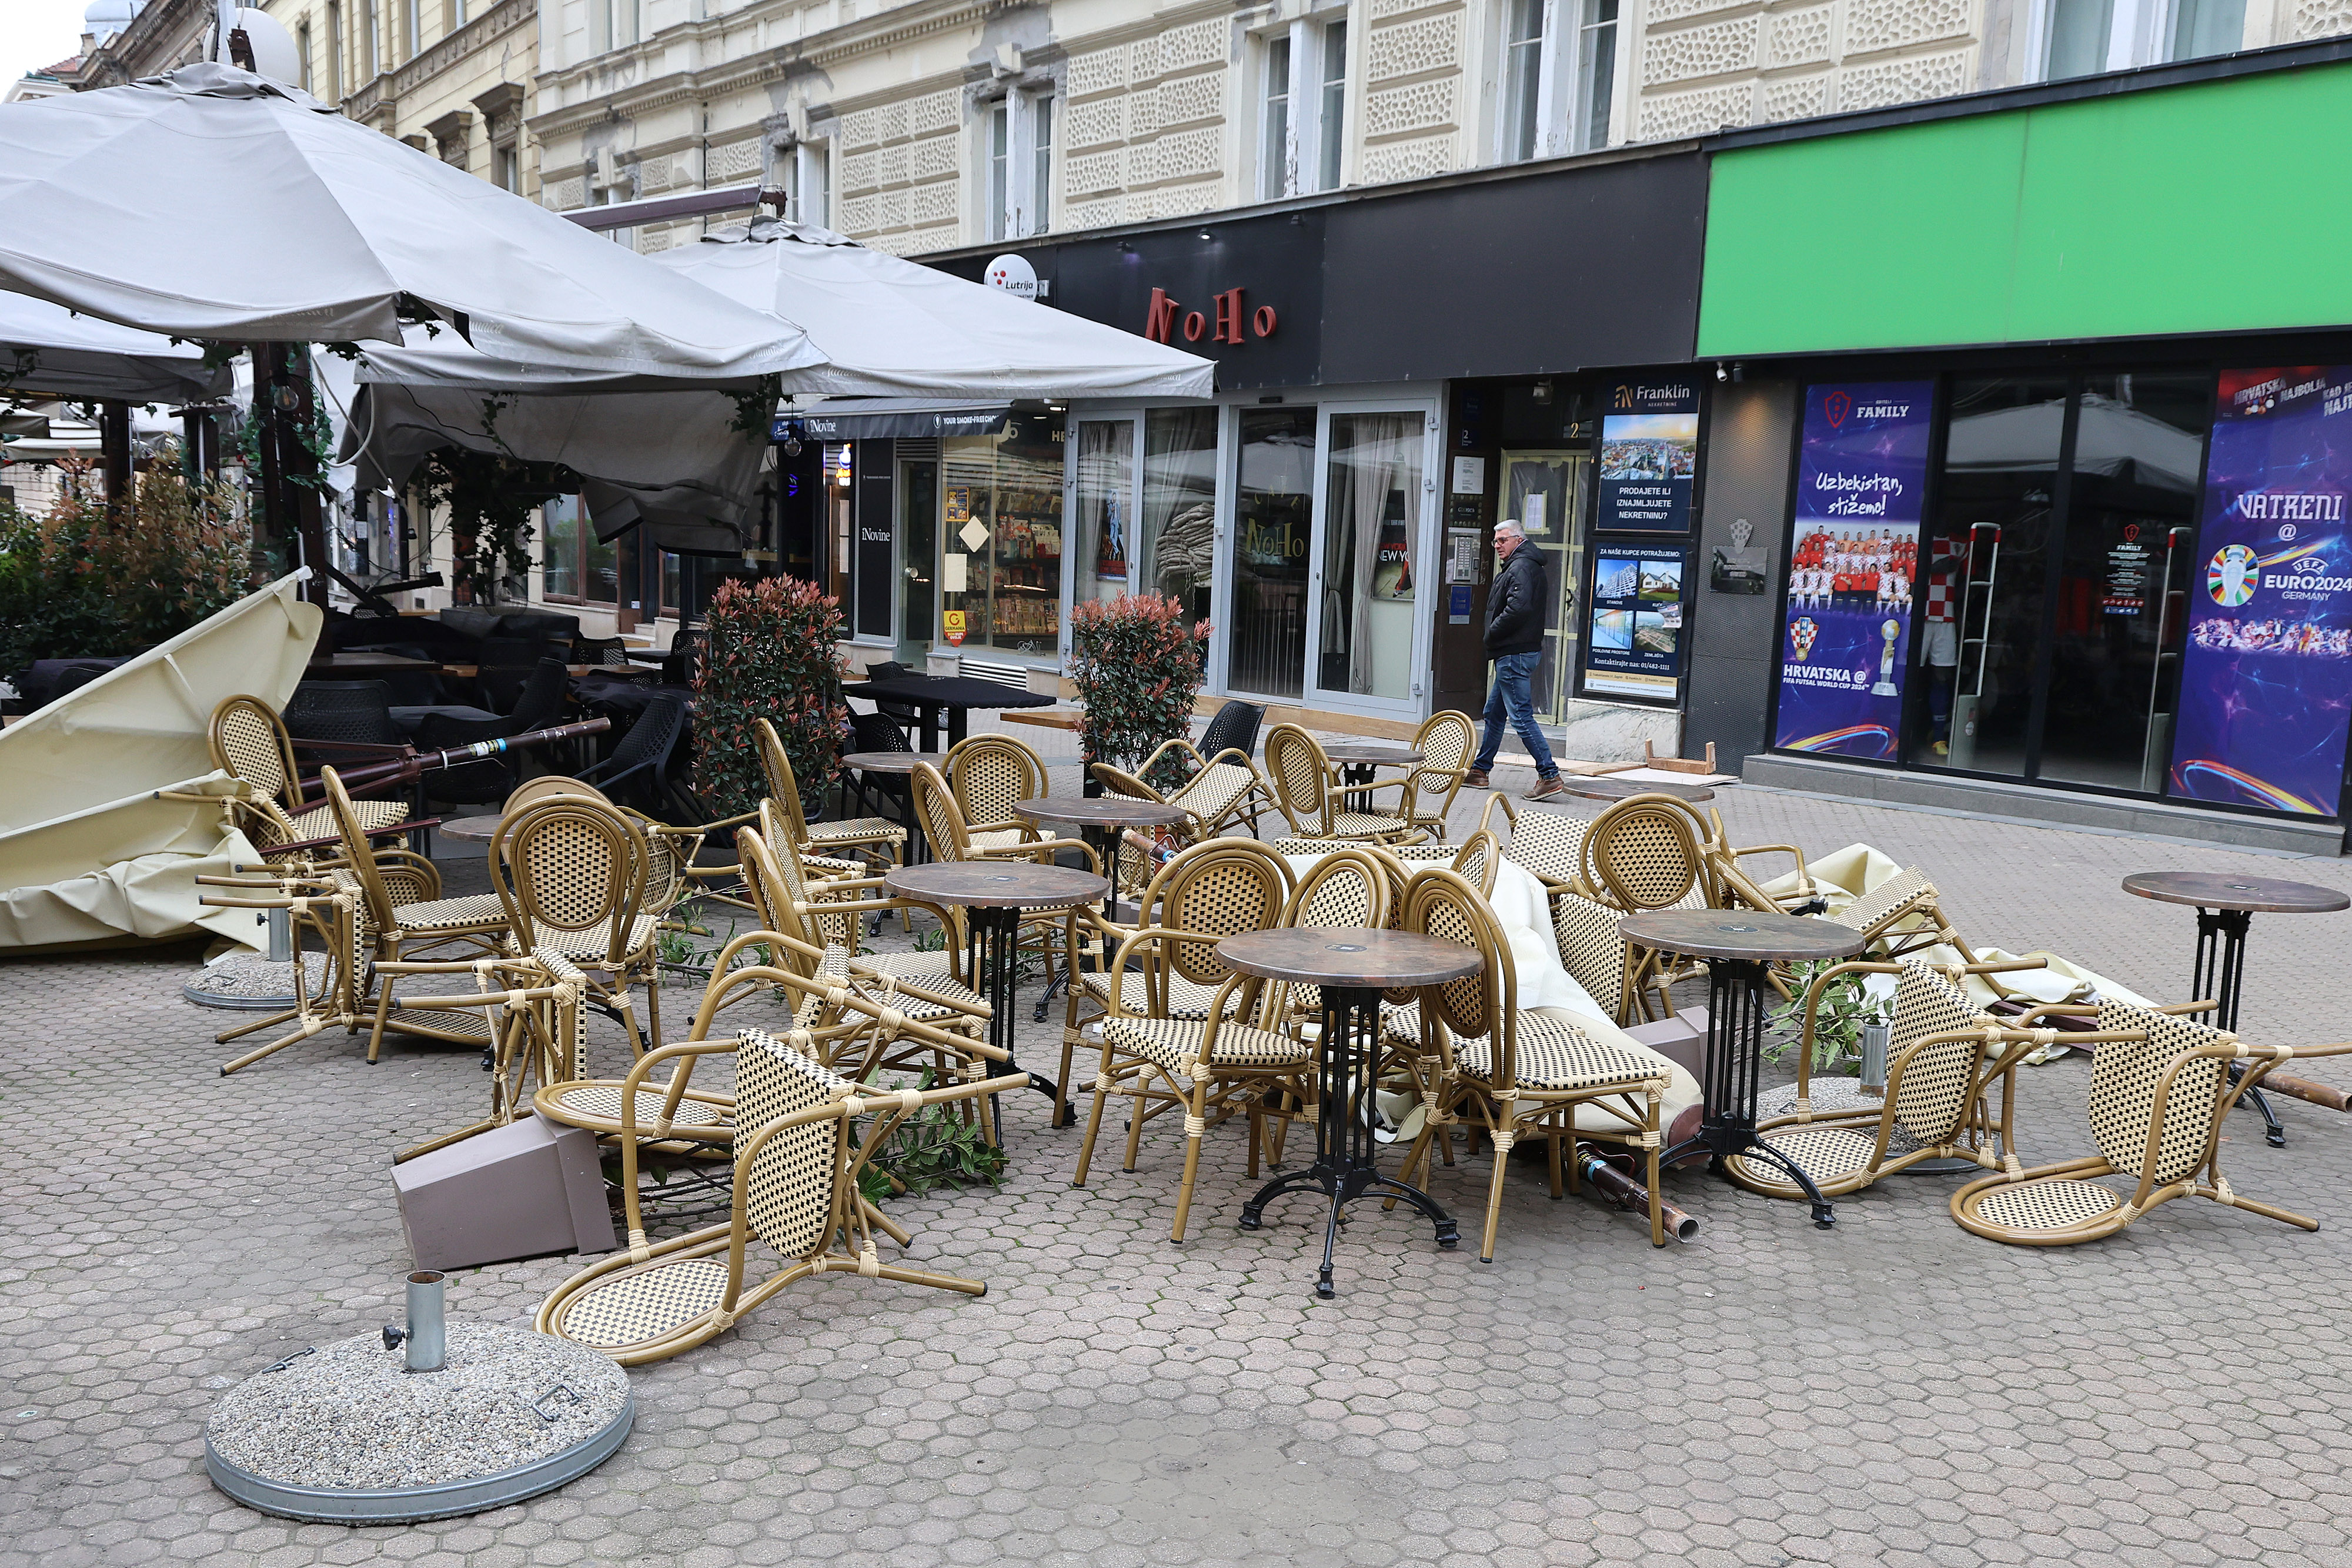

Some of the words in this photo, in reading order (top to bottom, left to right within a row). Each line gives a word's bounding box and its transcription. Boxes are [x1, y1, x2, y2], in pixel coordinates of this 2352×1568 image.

[1005, 280, 1033, 290] Lutrija
[1145, 287, 1277, 345] NoHo
[1636, 384, 1690, 400] Franklin
[1856, 406, 1910, 419] FAMILY
[810, 419, 837, 432] iNovine
[943, 416, 956, 424] YOUR
[1570, 422, 1579, 438] 2
[1816, 472, 1903, 496] Uzbekistan,
[1619, 487, 1661, 496] PRODAJETE
[1662, 487, 1671, 496] ILI
[1616, 499, 1672, 508] IZNAJMLJUJETE
[1828, 493, 1886, 516] stižemo!
[2237, 494, 2343, 520] VATRENI
[1619, 511, 1668, 520] NEKRETNINU?
[861, 527, 891, 541] iNovine
[1245, 518, 1304, 557] NoHo
[2278, 523, 2297, 541] @
[2293, 560, 2326, 573] UEFA
[2281, 591, 2331, 601] GERMANY
[1594, 658, 1628, 667] Kontaktirajte
[1783, 664, 1851, 682] HRVATSKA
[1853, 671, 1866, 683] @
